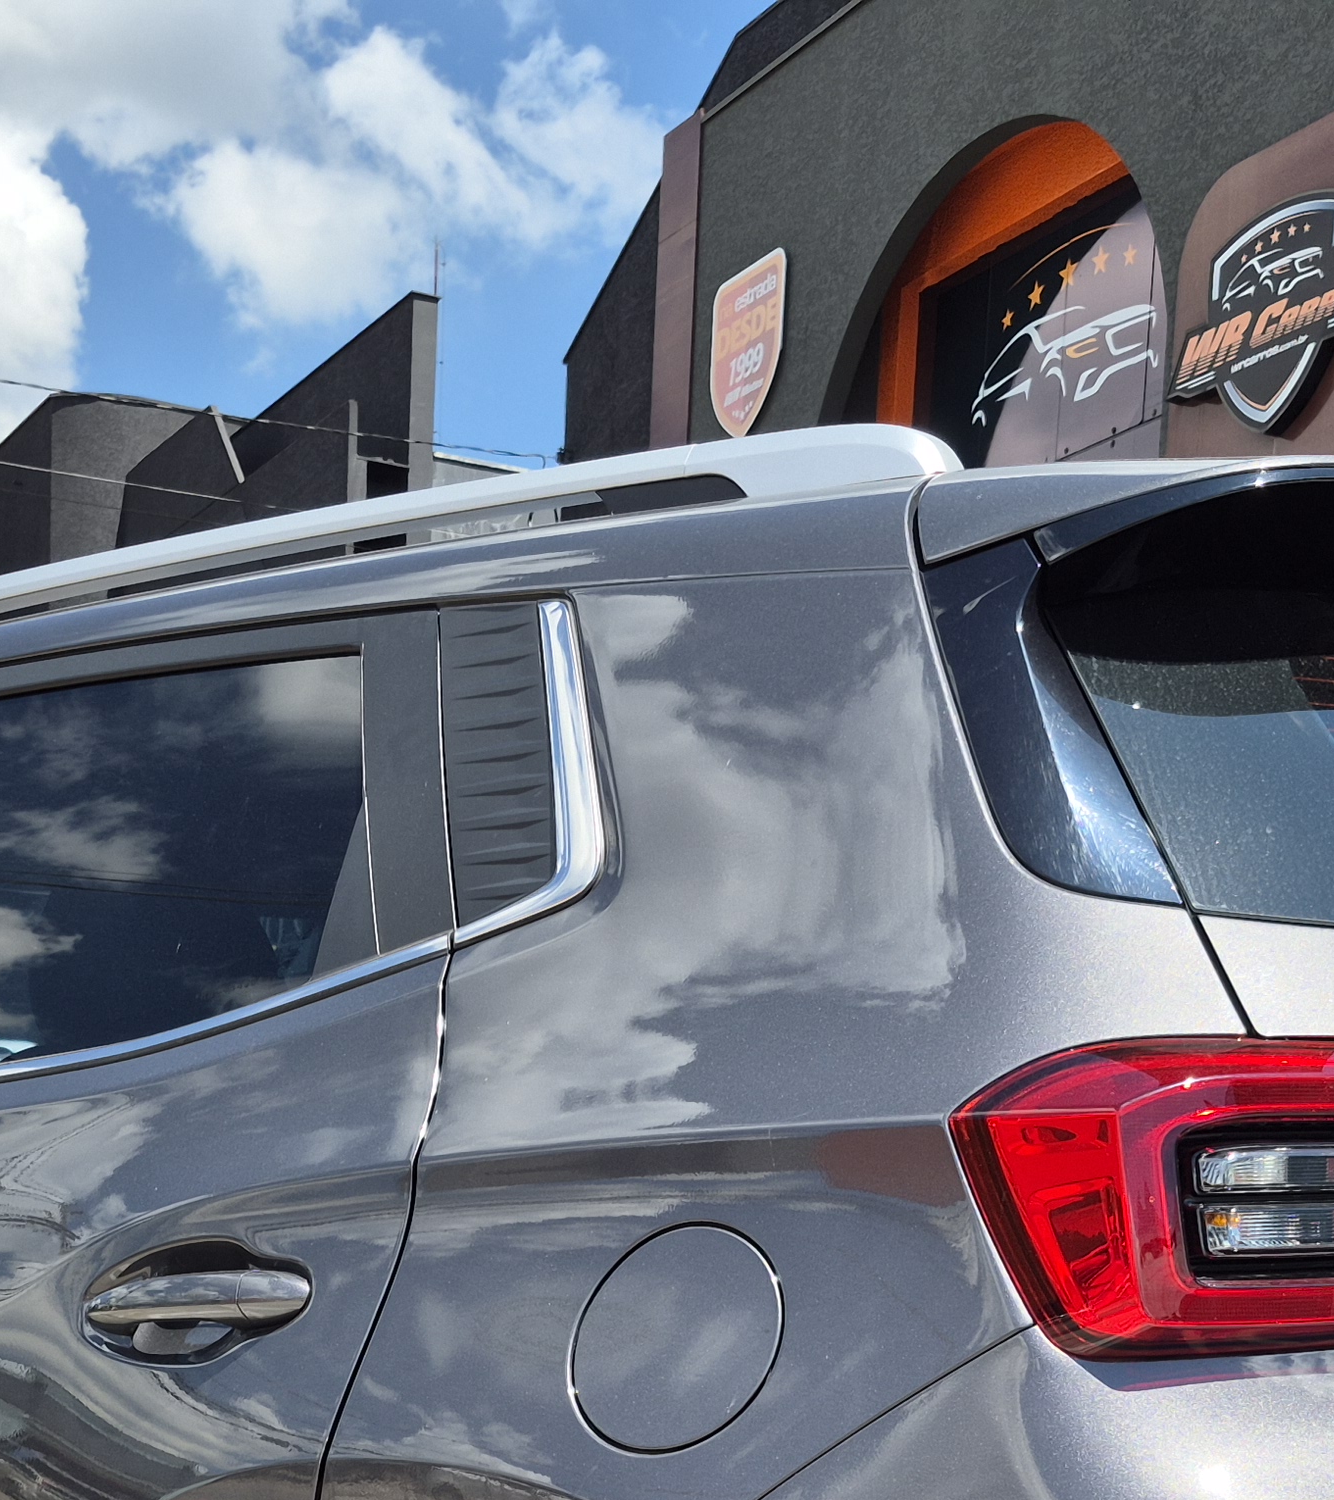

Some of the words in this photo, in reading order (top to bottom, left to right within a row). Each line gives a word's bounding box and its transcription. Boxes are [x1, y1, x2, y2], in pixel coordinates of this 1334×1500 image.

[735, 273, 777, 312] estrada
[717, 298, 779, 361] DESDE
[1176, 310, 1253, 384] WR
[729, 342, 764, 386] 1999
